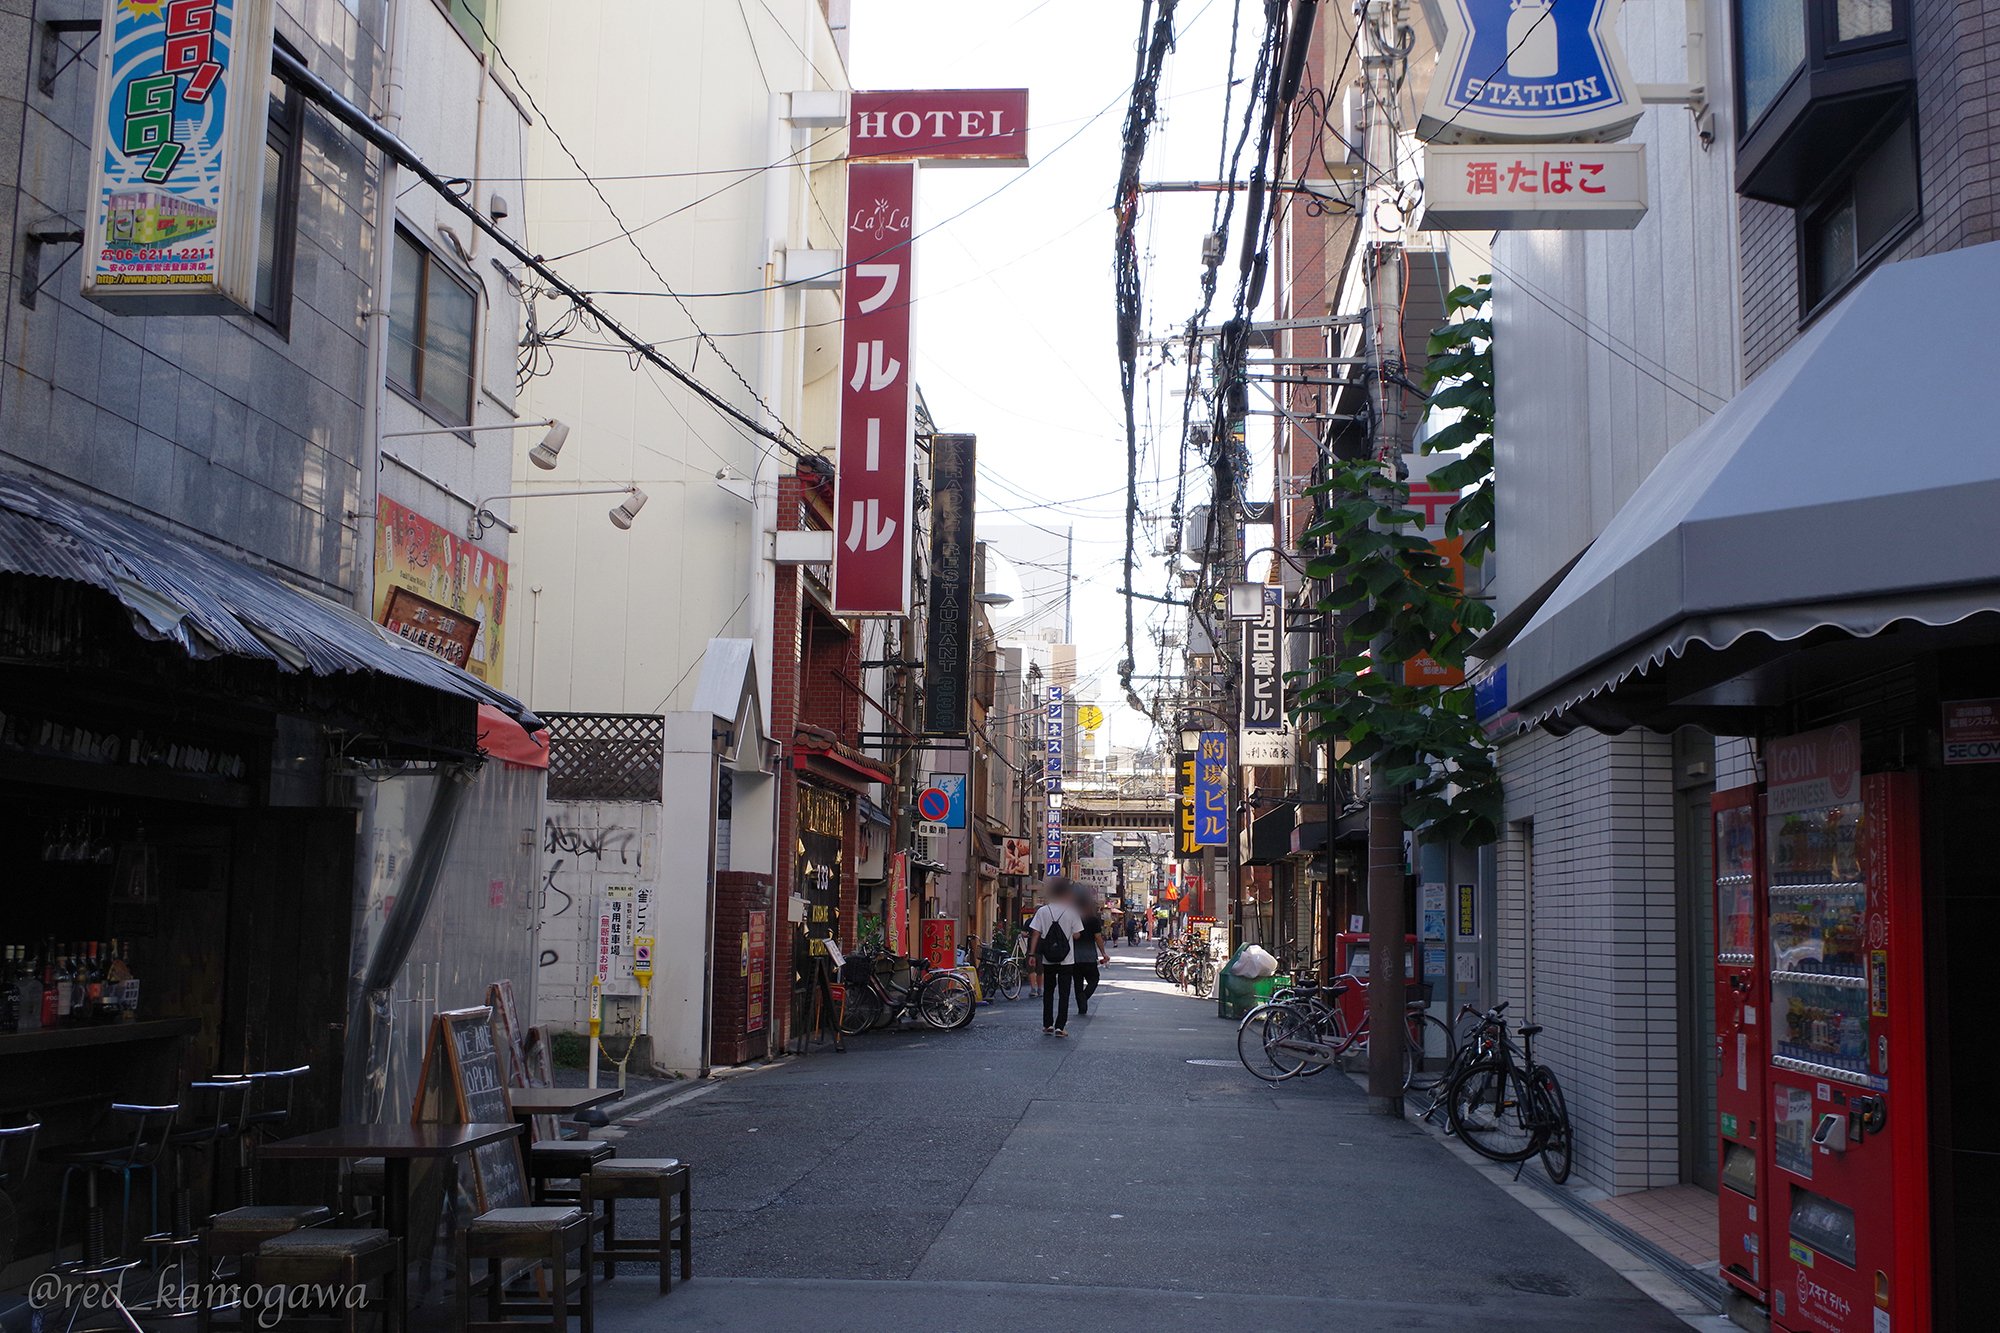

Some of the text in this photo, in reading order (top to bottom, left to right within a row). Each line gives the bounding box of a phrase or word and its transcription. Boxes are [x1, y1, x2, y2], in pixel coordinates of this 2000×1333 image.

[1464, 76, 1602, 107] STATION
[856, 110, 1016, 139] HOTEL
[1466, 160, 1607, 195] 酒・たばこ
[115, 247, 215, 261] 06-6211-2211
[844, 263, 901, 552] フルール
[938, 543, 961, 673] RESTAURANT
[1203, 738, 1227, 837] 的場ビル
[919, 824, 947, 836] 自動車
[610, 900, 622, 956] 専用駐車場
[474, 1025, 494, 1054] ARE
